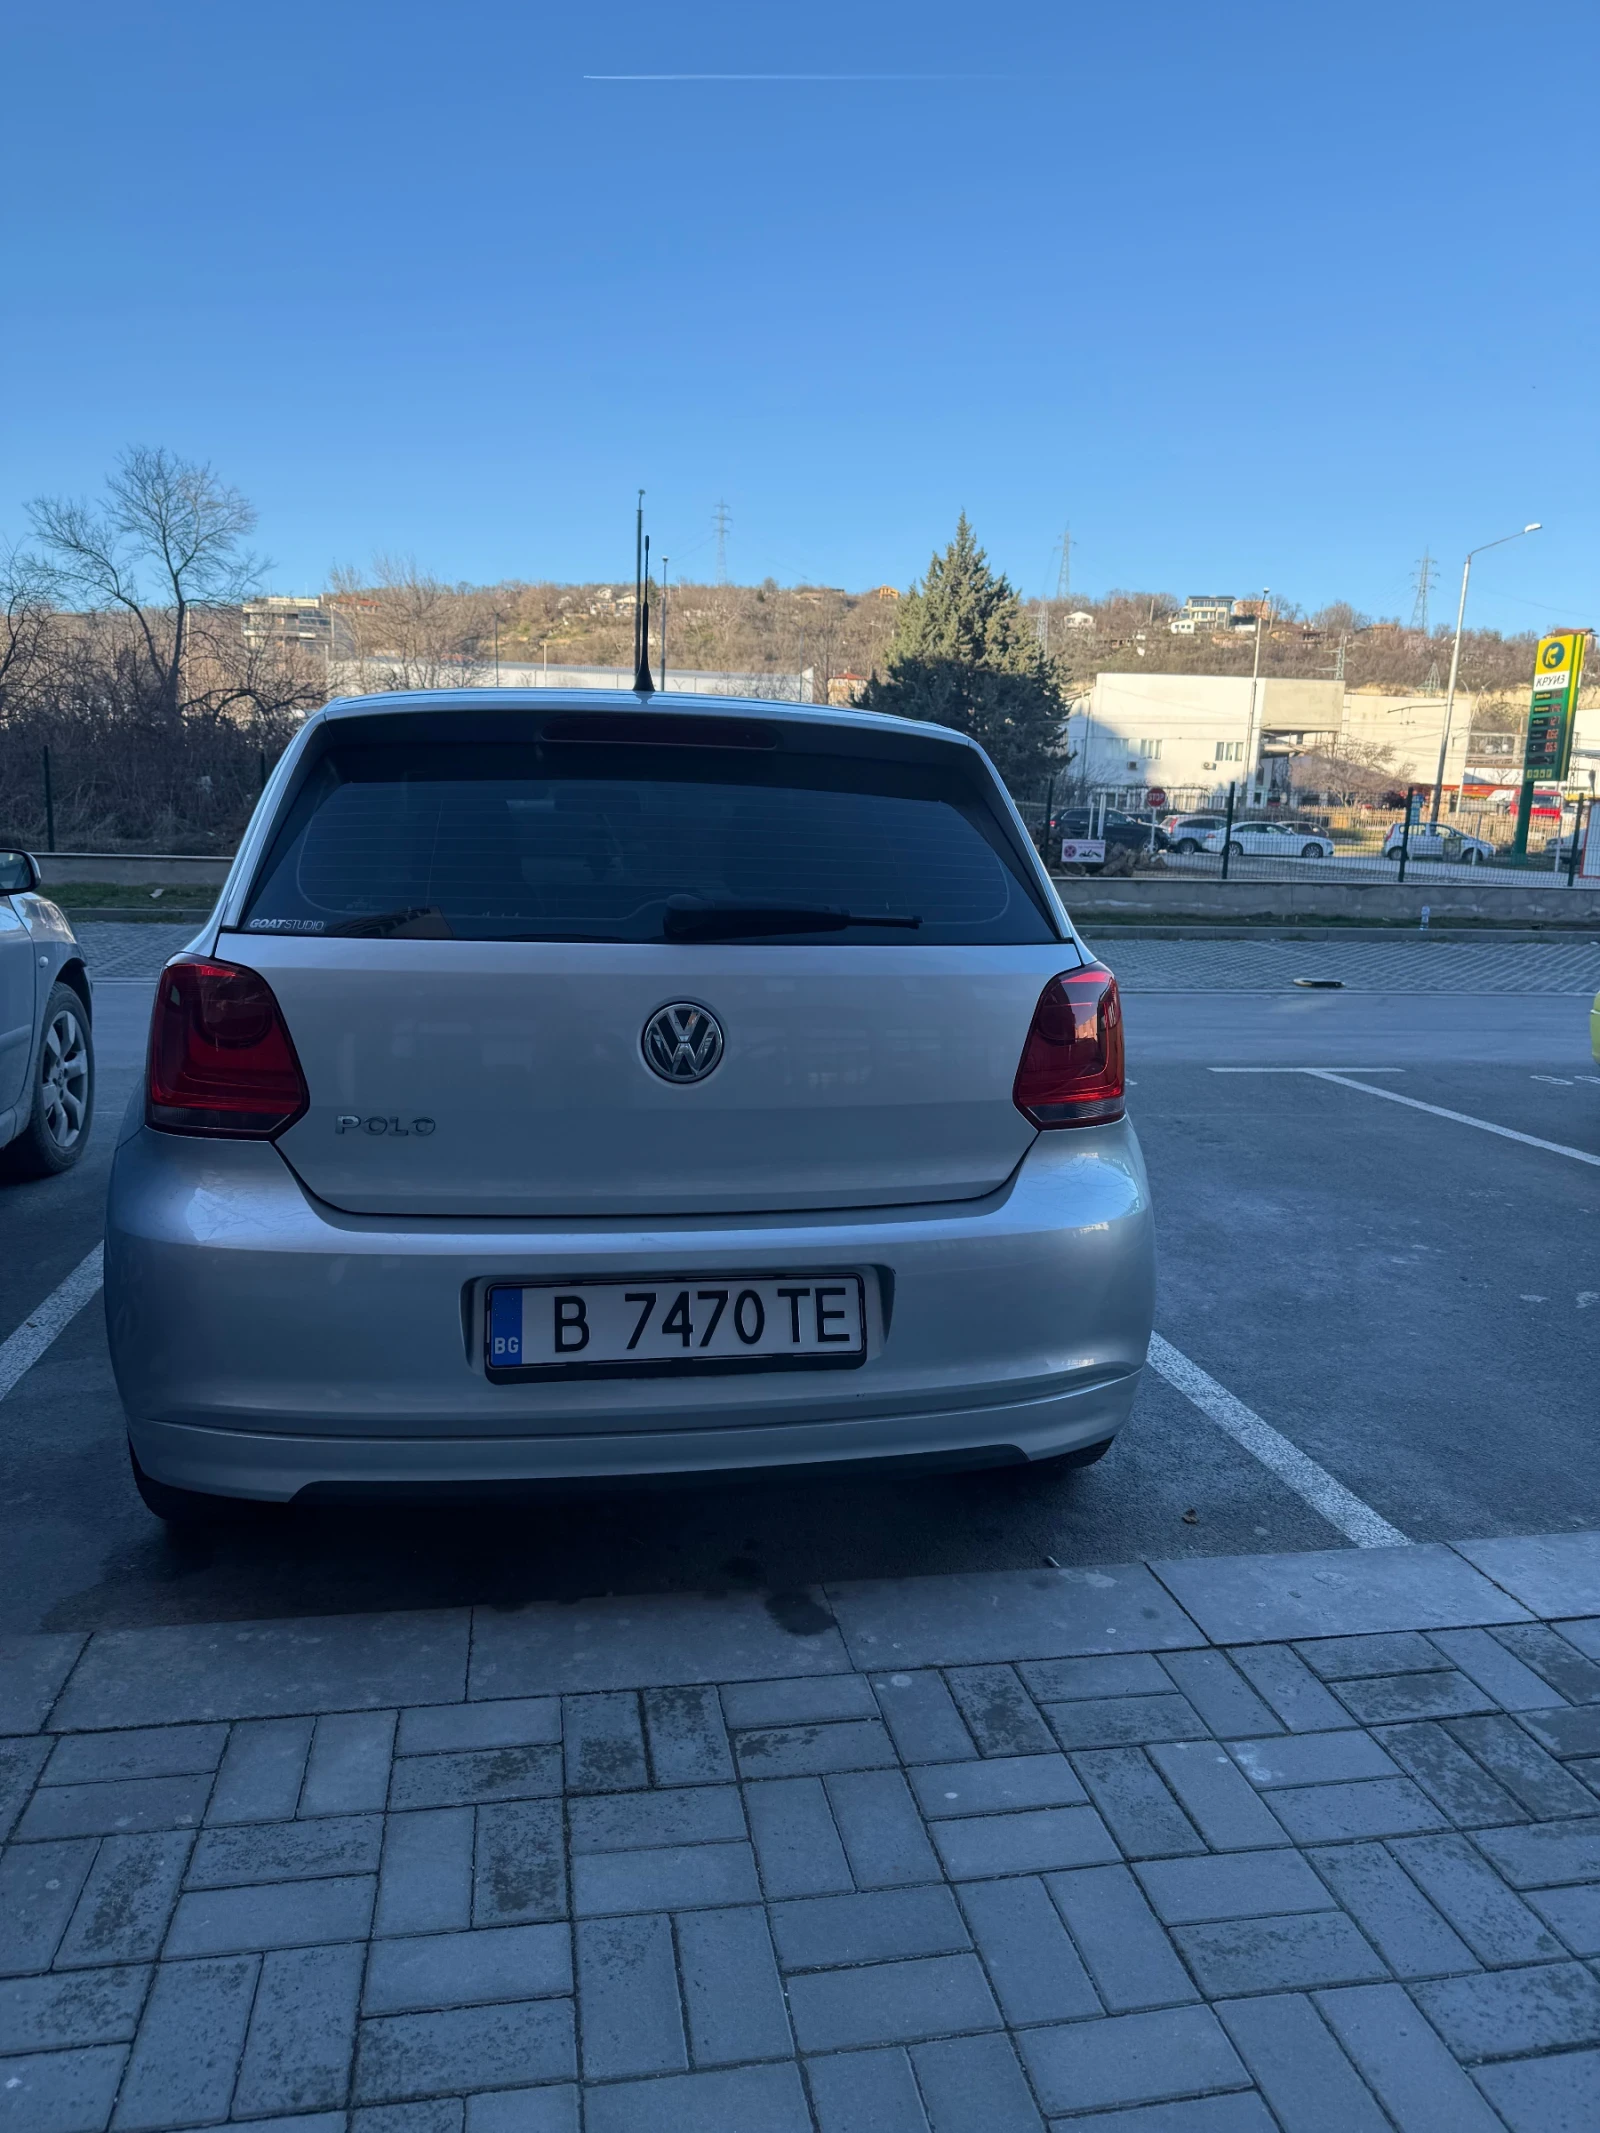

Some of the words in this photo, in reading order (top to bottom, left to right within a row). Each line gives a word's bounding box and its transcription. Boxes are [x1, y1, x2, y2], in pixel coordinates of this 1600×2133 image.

[1536, 674, 1566, 688] КРУИЗ
[1147, 792, 1165, 802] STOP
[335, 1115, 436, 1137] POLO
[553, 1295, 591, 1354] B
[624, 1289, 766, 1350] 7470
[777, 1287, 851, 1343] TE
[494, 1336, 520, 1355] BG
